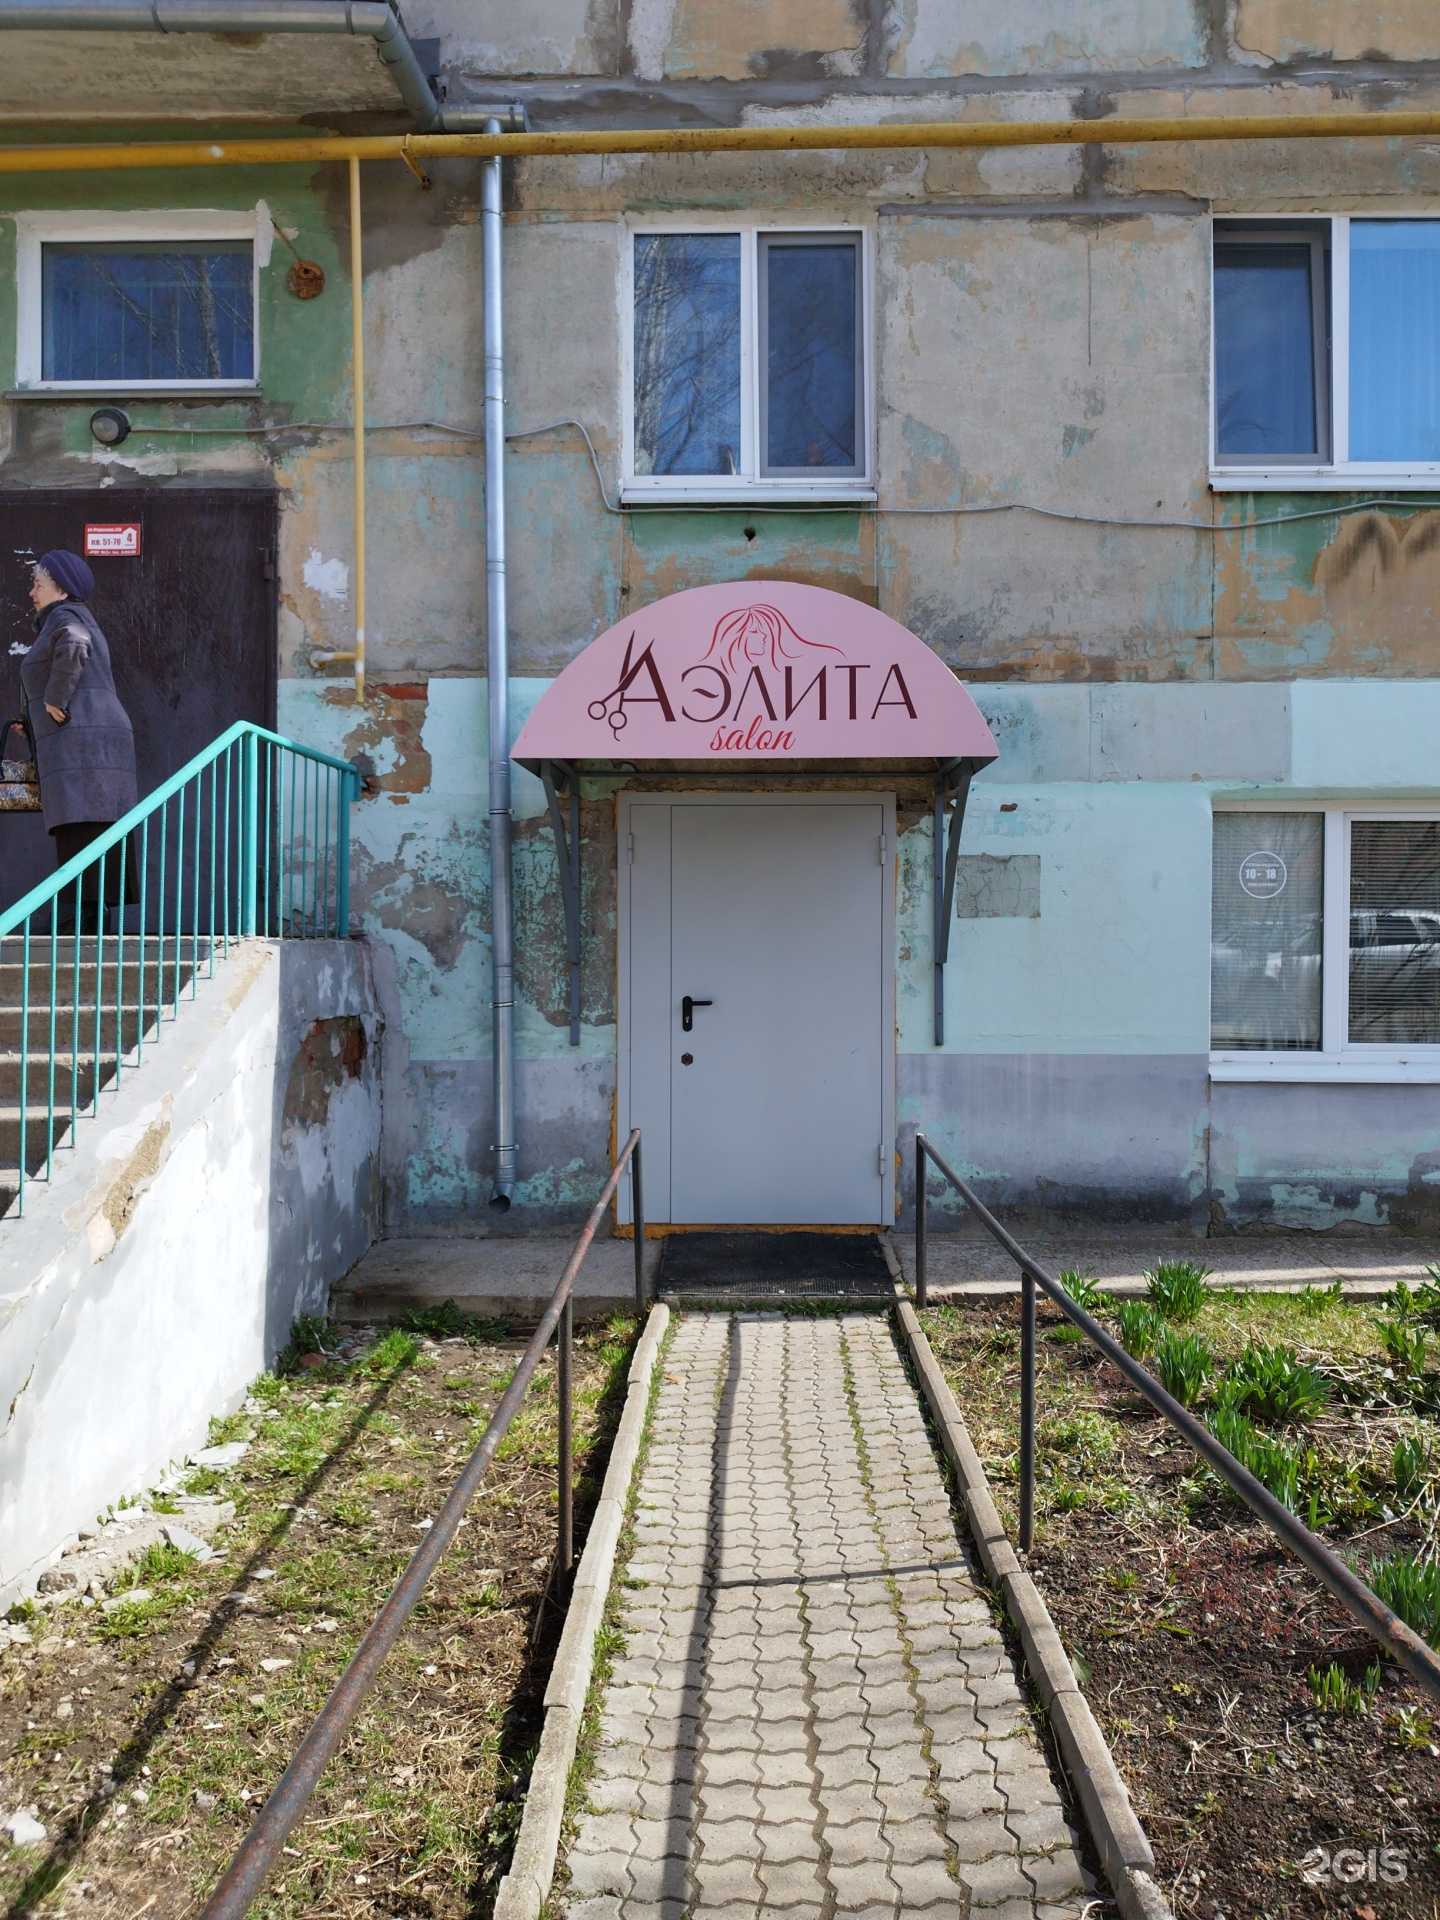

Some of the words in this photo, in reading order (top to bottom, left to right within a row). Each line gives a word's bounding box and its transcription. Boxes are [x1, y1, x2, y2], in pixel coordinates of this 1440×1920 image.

[127, 533, 132, 543] 4
[602, 632, 918, 724] АЭЛИТА
[710, 715, 797, 752] salon
[1265, 868, 1277, 880] 18
